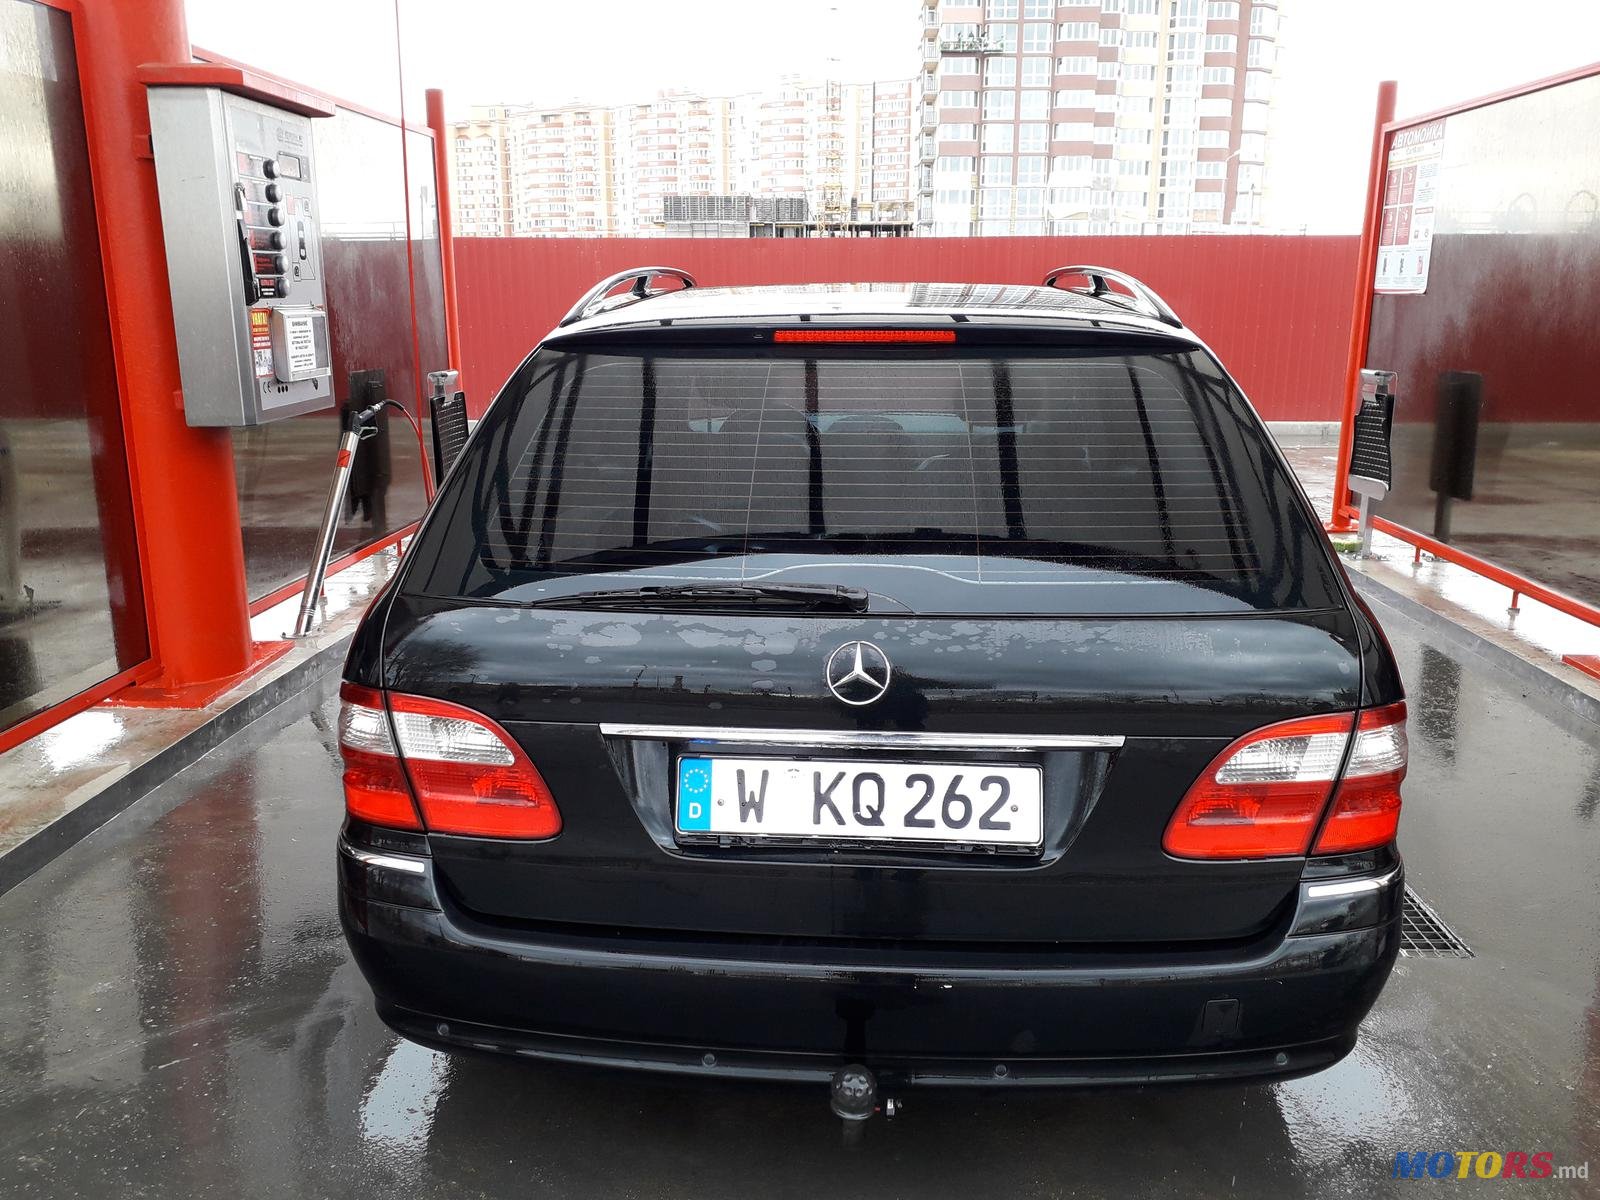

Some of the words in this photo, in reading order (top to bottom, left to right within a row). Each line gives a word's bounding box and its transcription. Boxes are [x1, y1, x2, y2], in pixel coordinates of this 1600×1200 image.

[1392, 124, 1443, 149] АВТОМОЙКА
[688, 802, 702, 819] D
[736, 768, 769, 823] W
[813, 771, 885, 826] KQ
[903, 773, 1011, 831] 262
